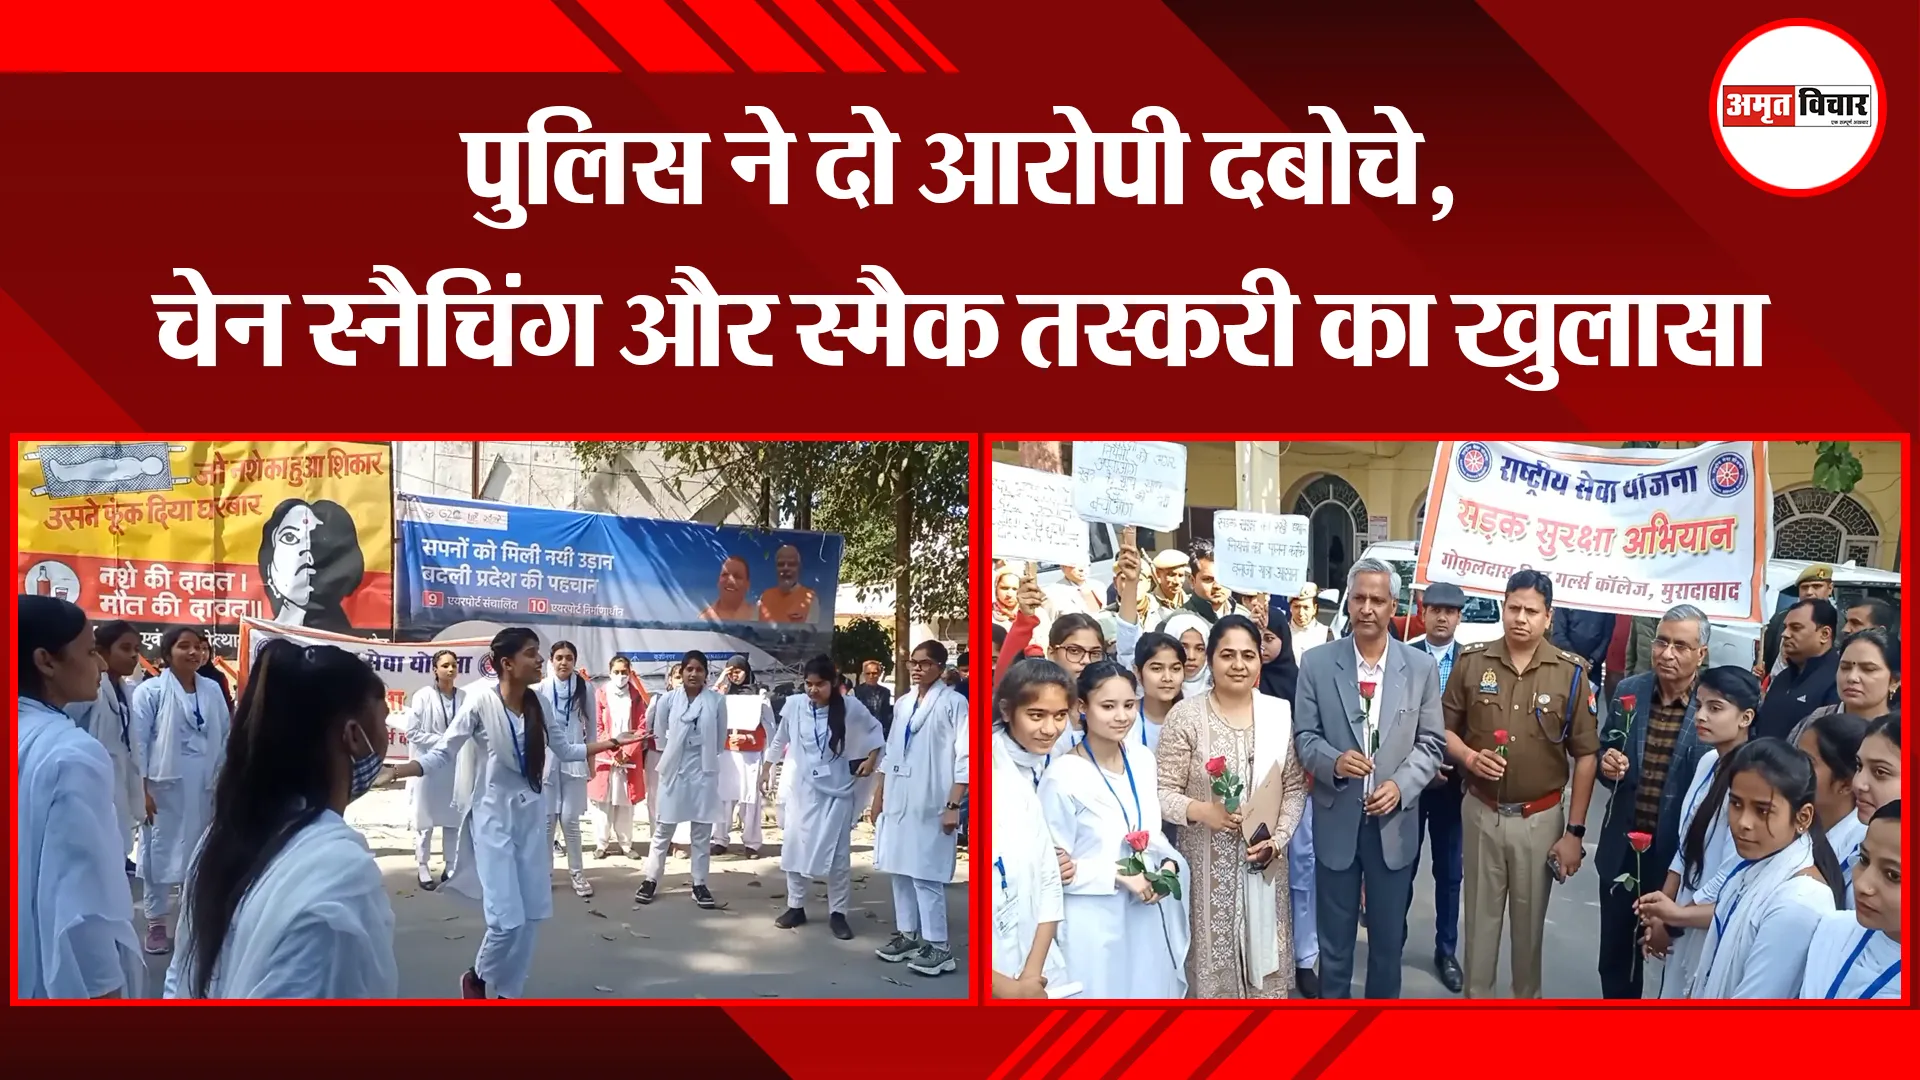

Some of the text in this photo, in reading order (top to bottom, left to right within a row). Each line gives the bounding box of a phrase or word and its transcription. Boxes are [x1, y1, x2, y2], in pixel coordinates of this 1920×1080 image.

[194, 447, 384, 487] जो नशे का हुआ शिकार
[1501, 455, 1572, 496] राष्ट्रीय
[1575, 470, 1621, 503] सेवा
[44, 498, 101, 530] उसने
[146, 494, 195, 530] दिया
[197, 495, 263, 520] घरबार
[1456, 497, 1738, 559] सड़क सुरक्षा अभियान
[421, 537, 614, 573] सपनों को मिली नयी उड़ान
[99, 561, 137, 589] नशे
[144, 564, 173, 589] की
[421, 564, 599, 594] बदली प्रदेश की पहचान
[1441, 549, 1513, 579] गोकुलदास
[1556, 569, 1592, 591] गर्ल्स
[1595, 569, 1654, 600] कॉलेज,
[1661, 580, 1742, 604] मुरादाबाद
[99, 590, 146, 616] मौत
[151, 592, 182, 617] की
[429, 594, 437, 606] 9
[483, 597, 519, 610] संचालित
[531, 600, 546, 612] 10
